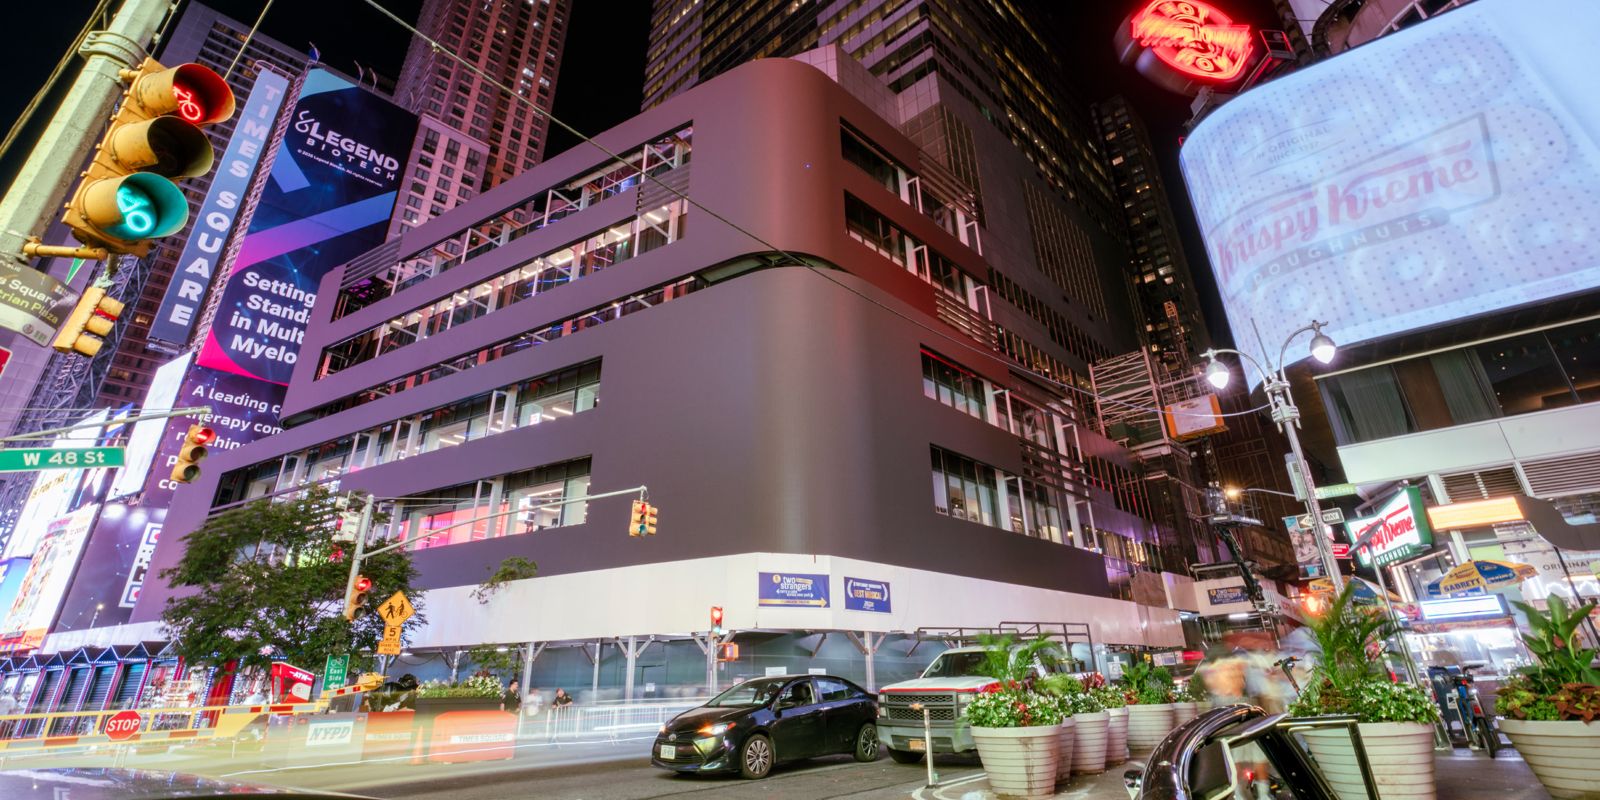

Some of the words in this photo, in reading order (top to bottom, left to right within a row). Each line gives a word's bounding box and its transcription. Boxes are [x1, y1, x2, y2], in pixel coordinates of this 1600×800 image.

[229, 84, 281, 178] TIMES
[309, 121, 399, 171] LEGEND
[306, 137, 395, 181] BIOTECH
[1216, 189, 1319, 285] Krispy
[1327, 138, 1479, 226] Kreme
[169, 190, 237, 326] SQUARE
[1252, 213, 1433, 287] DOUGHNUTS
[8, 278, 58, 309] Square
[243, 271, 317, 308] Setting
[230, 311, 252, 331] in
[192, 385, 205, 398] A
[208, 387, 268, 413] leading
[23, 452, 41, 466] W
[48, 451, 78, 465] 48
[84, 450, 105, 464] St
[1374, 545, 1411, 565] OUGHNUTS
[780, 582, 812, 592] strangers
[783, 576, 796, 584] two
[1443, 577, 1481, 592] SABRETT
[389, 627, 397, 637] 5
[293, 671, 309, 681] ATM
[107, 718, 140, 732] STOP
[309, 726, 351, 741] NYPD
